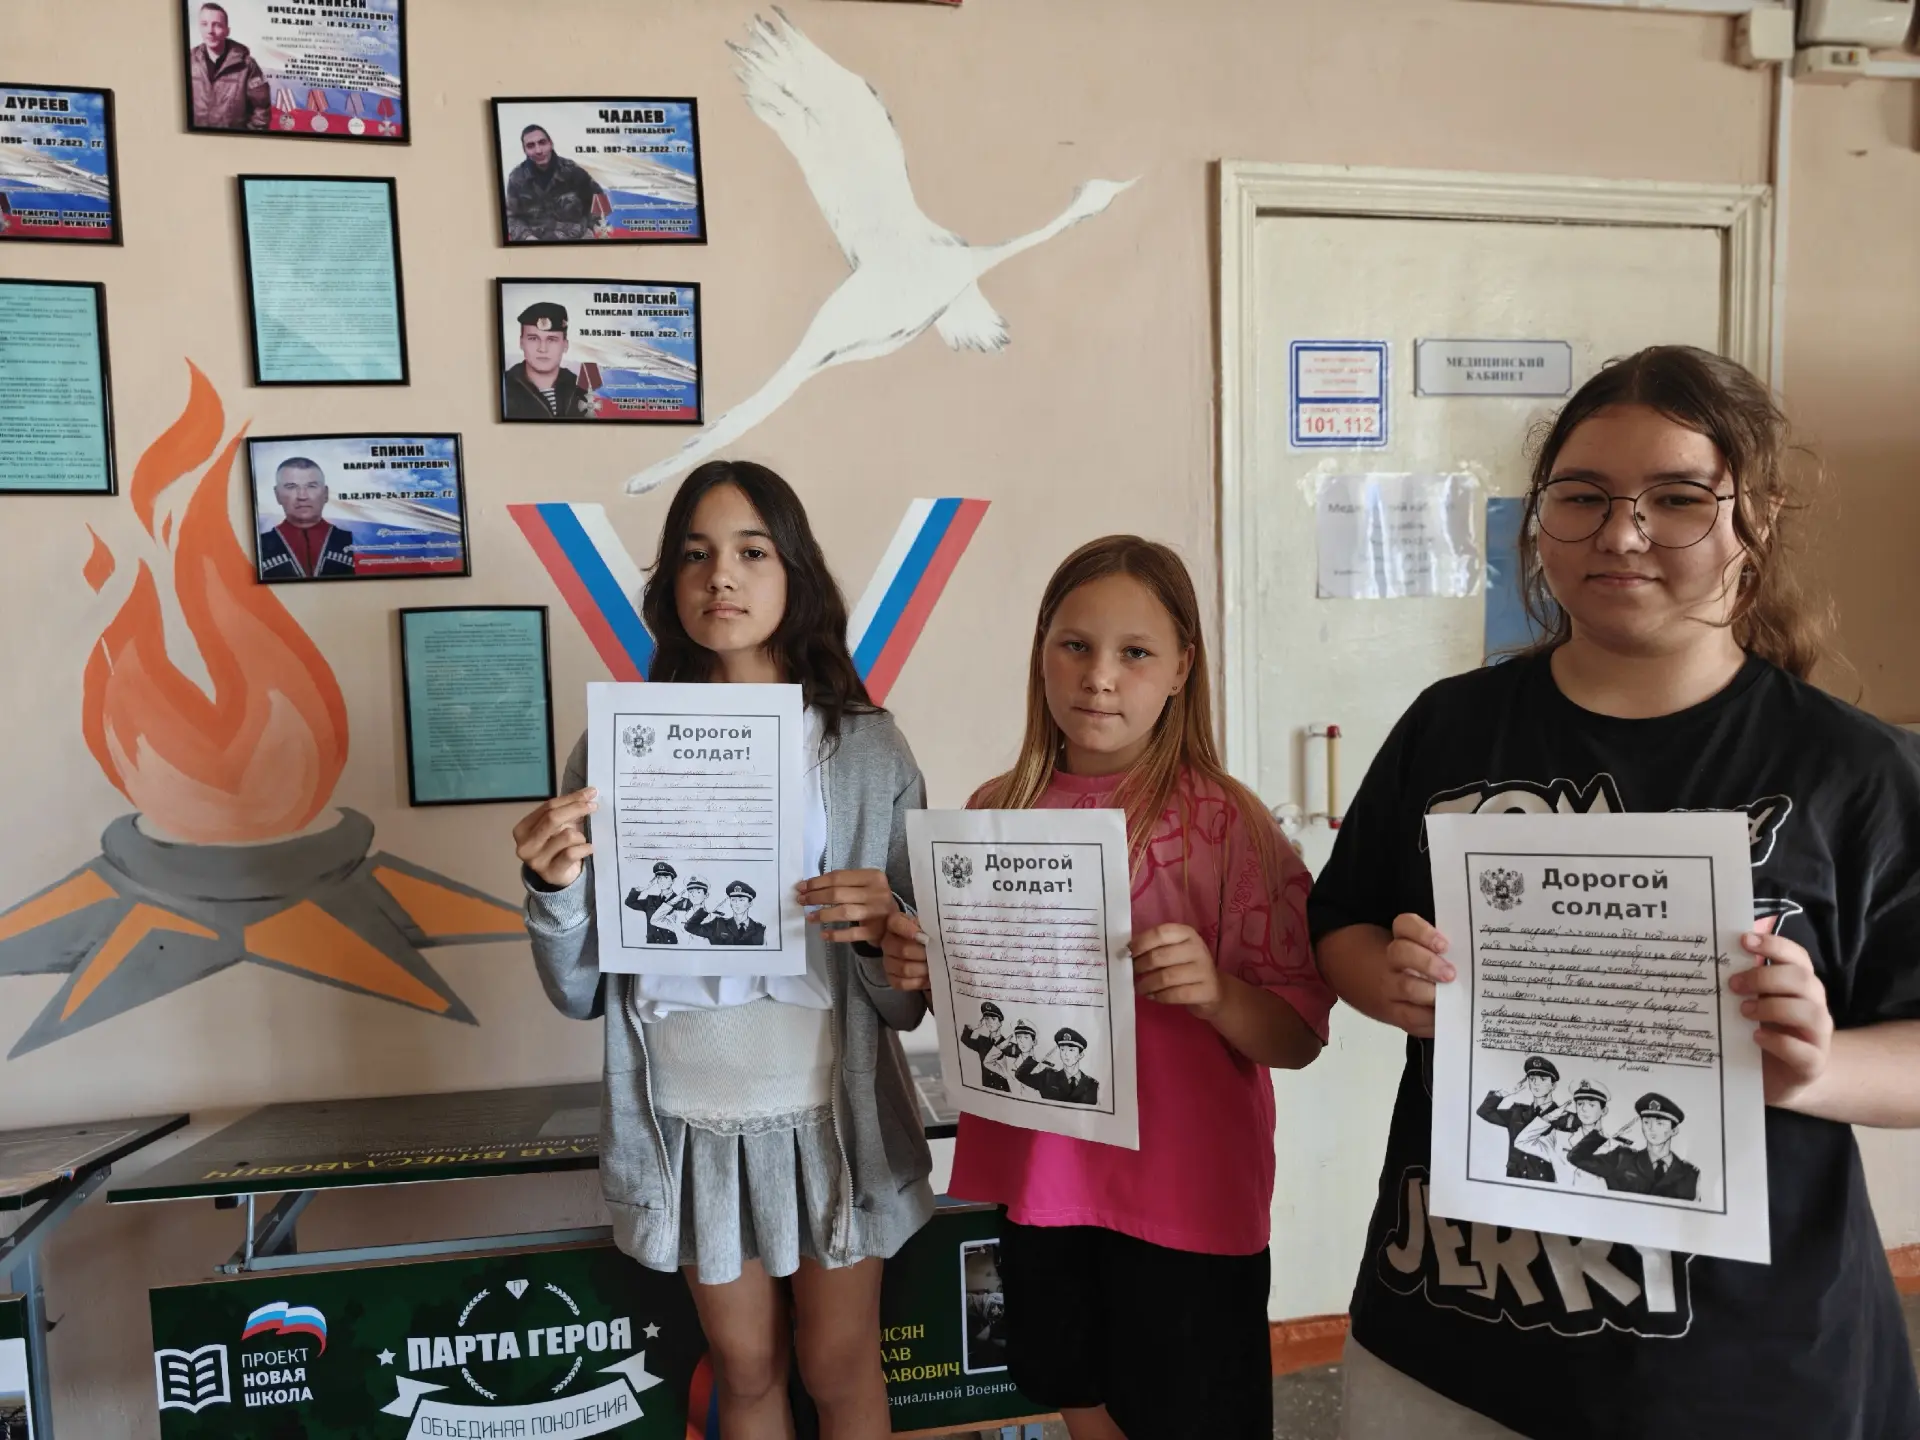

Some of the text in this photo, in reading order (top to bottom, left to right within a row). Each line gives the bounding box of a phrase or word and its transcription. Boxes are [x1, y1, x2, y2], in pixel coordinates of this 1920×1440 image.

[5, 96, 69, 111] ДУРЕЕВ
[21, 115, 88, 125] АНАТОЛЬЕВИЧ
[599, 109, 665, 123] ЧАДАЕВ
[586, 126, 675, 135] НИКОЛАЙ ГЕННАДЬЕВИЧ
[593, 291, 677, 305] ПАВЛОВСКИЙ
[637, 309, 690, 317] АЛЕКСЕЕВИЧ
[1447, 356, 1545, 368] МЕДИЦИНСКИЙ
[1466, 371, 1524, 382] КАБИНЕТ
[343, 460, 449, 470] ВАЛЕРИЙ ВИКТОРОВИЧ
[667, 724, 752, 741] Дорогой
[673, 747, 750, 761] солдат!
[985, 853, 1073, 872] Дорогой
[992, 878, 1073, 894] солдат!
[1541, 868, 1669, 891] Дорогой
[1551, 900, 1668, 919] солдат!
[202, 1150, 506, 1180] ВЯЧЕСЛАВОВИЧ
[406, 1316, 632, 1372] ПАРТА ГЕРОЯ
[241, 1348, 309, 1368] ПРОЕКТ
[243, 1367, 306, 1388] НОВАЯ
[244, 1386, 314, 1407] ШКОЛА
[421, 1394, 628, 1440] ОБЪЕДИНЯЯ ПОКОЛЕНИЯ
